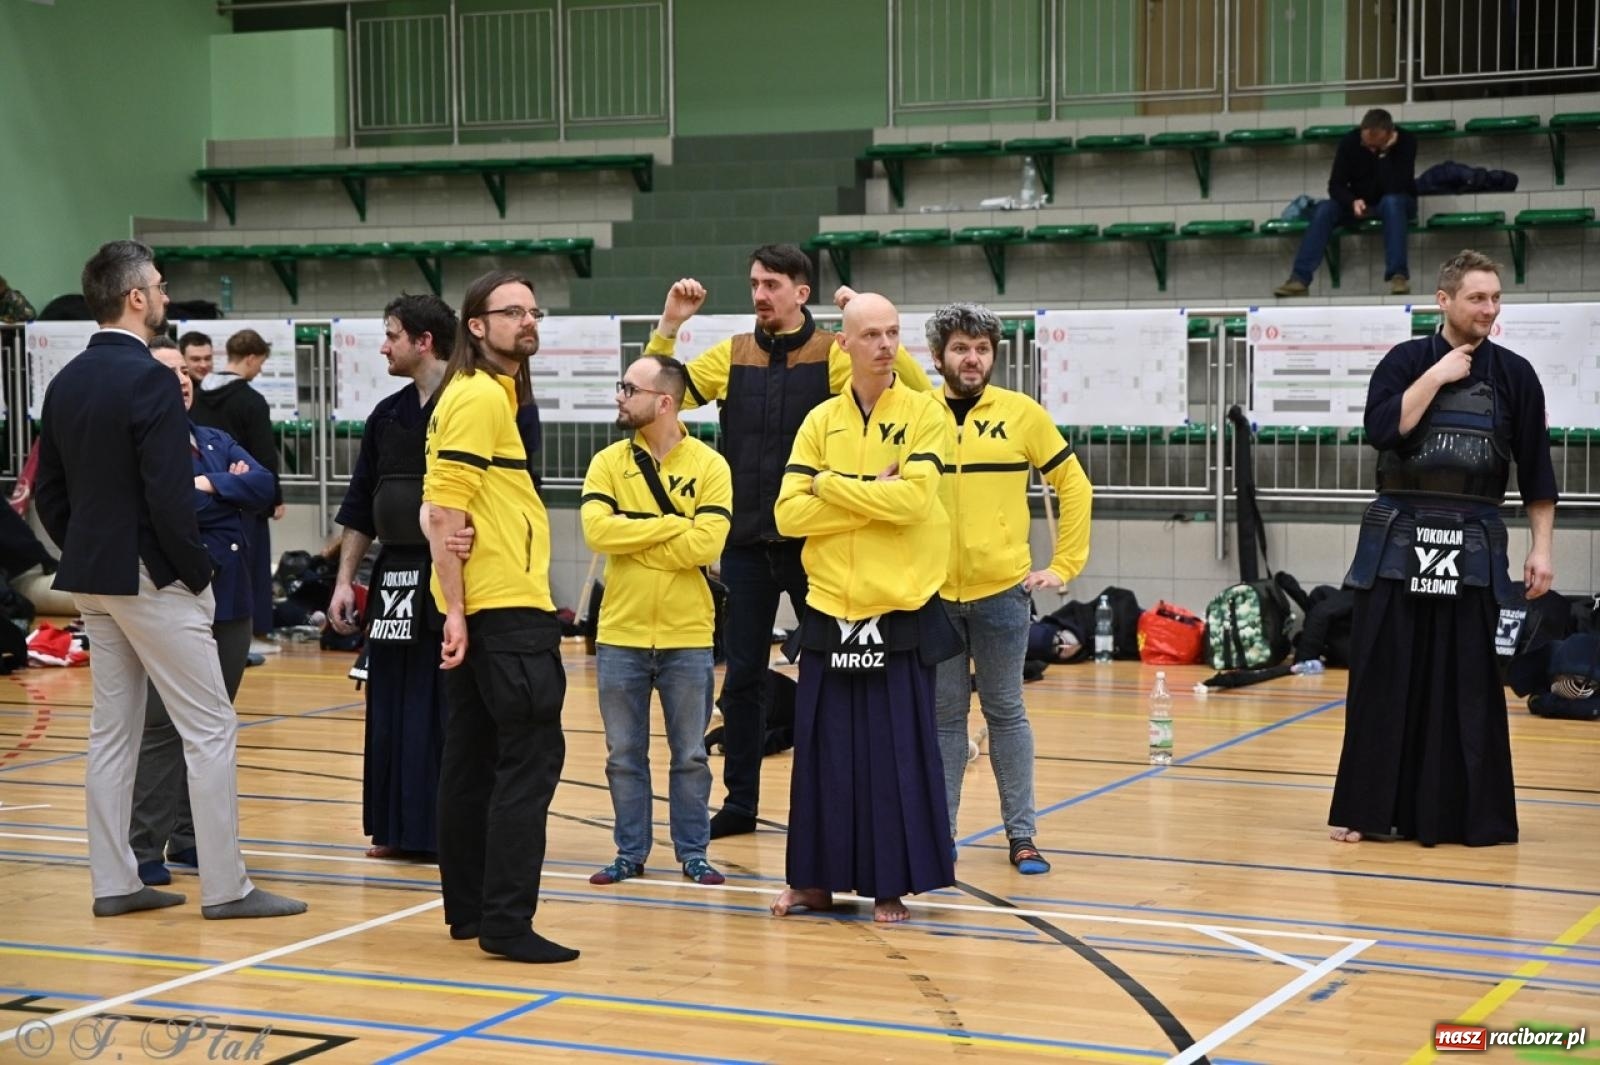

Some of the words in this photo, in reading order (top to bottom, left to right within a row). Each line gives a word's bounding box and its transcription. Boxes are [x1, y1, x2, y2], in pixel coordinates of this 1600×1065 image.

[1416, 526, 1464, 546] YOKOKAN
[369, 618, 412, 640] RITSZEL
[831, 648, 885, 668] MRÓZ
